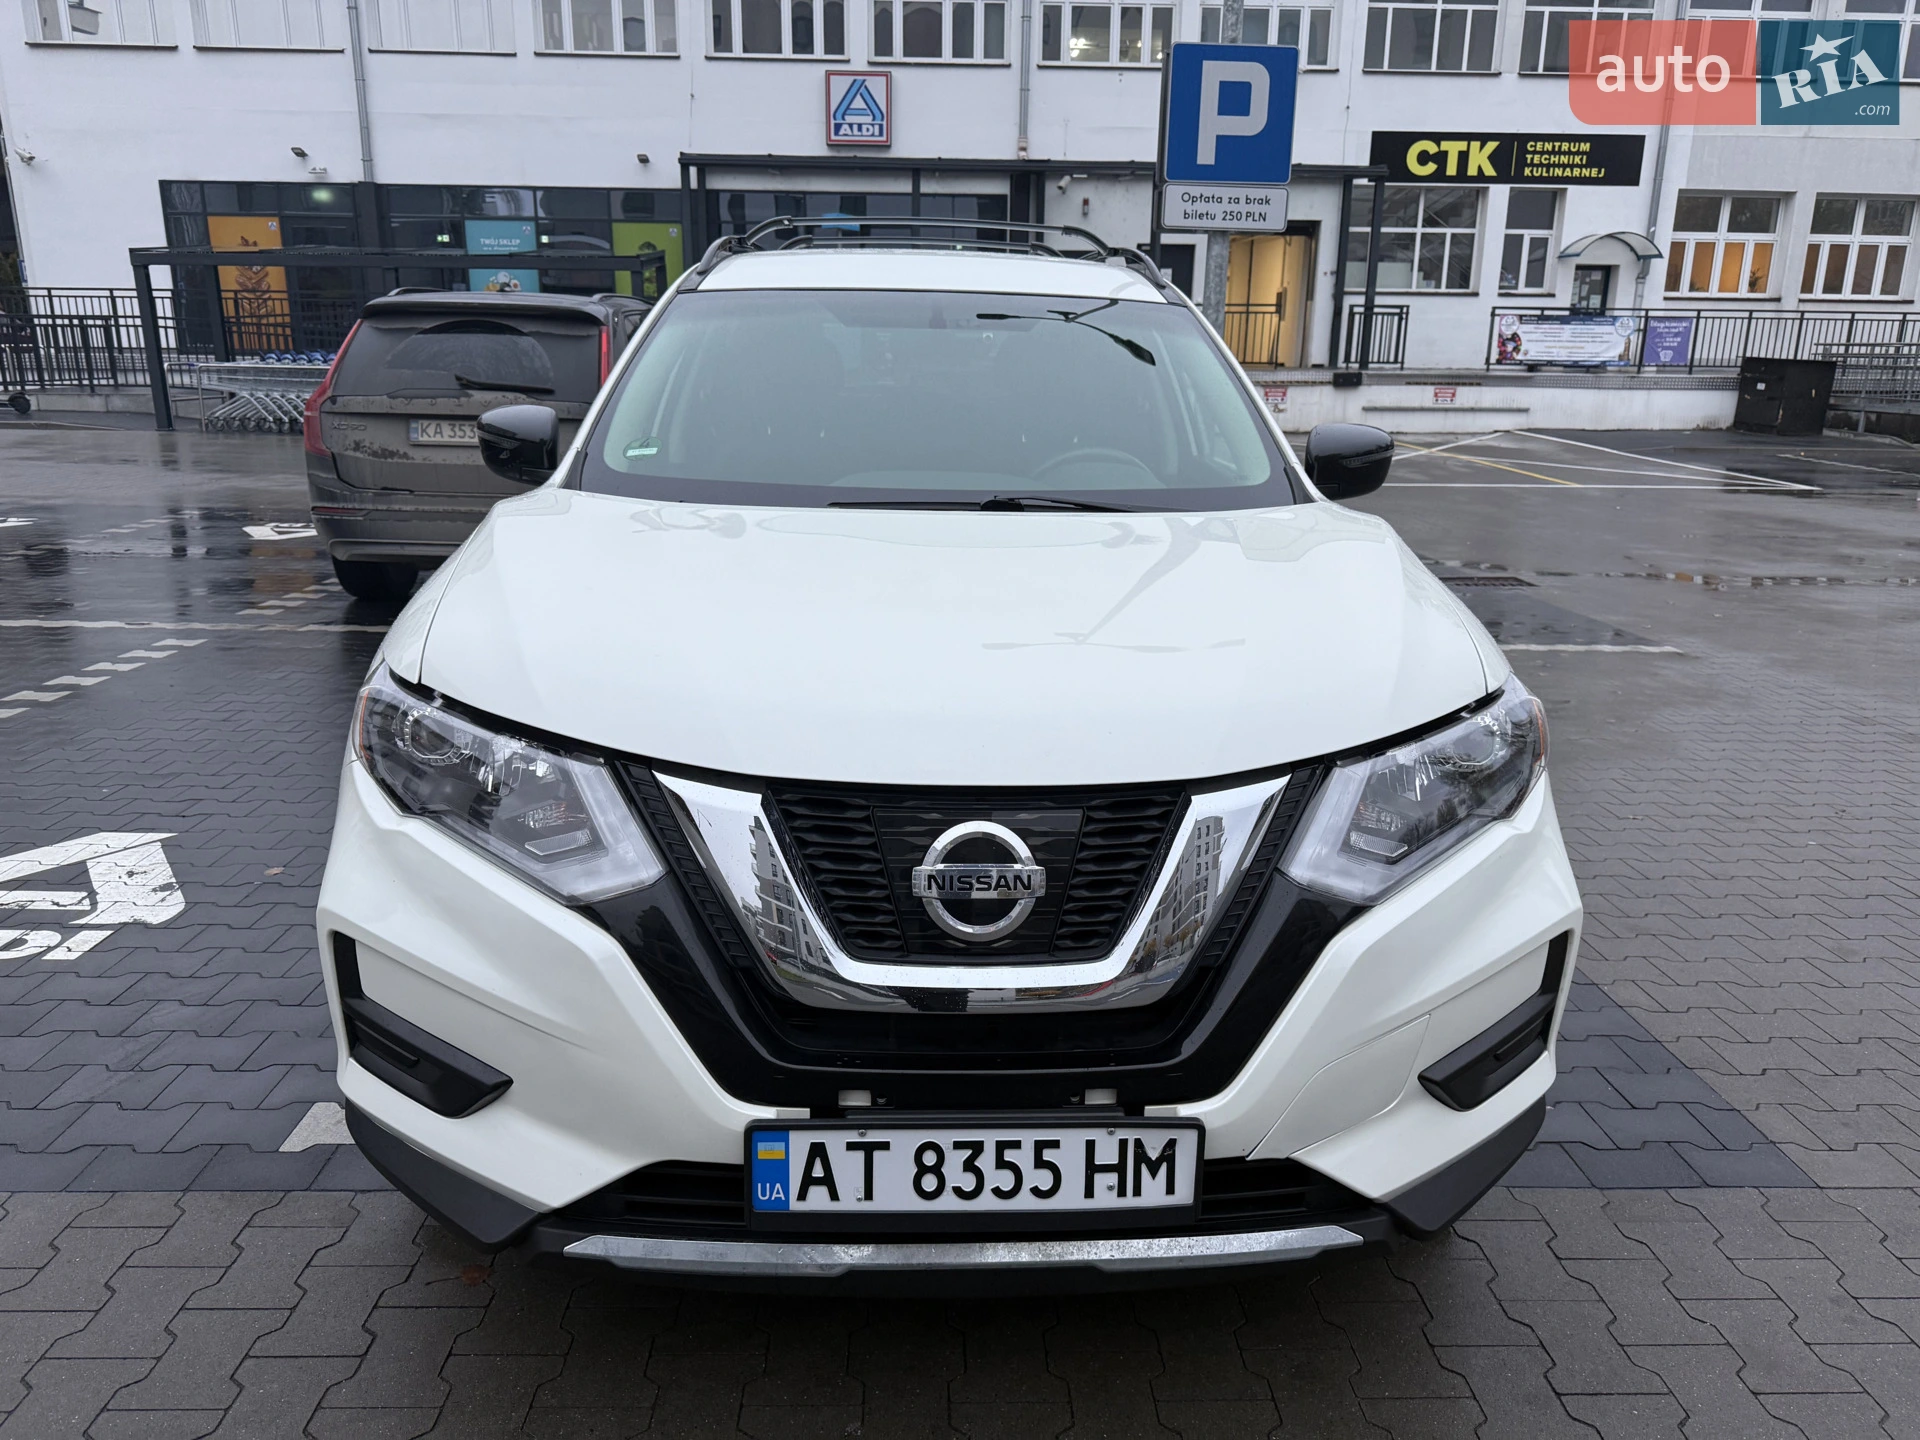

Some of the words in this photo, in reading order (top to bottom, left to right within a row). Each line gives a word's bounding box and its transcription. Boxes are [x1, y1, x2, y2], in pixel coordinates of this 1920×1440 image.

[1196, 60, 1271, 165] P
[838, 123, 880, 136] ALDI
[1526, 141, 1591, 152] CENTRUM
[1405, 139, 1500, 177] CTK
[1525, 154, 1587, 165] TECHNIKI
[1523, 167, 1605, 178] KULINARNEJ
[1181, 191, 1223, 206] Opłata
[1227, 196, 1240, 205] za
[1245, 194, 1271, 206] brak
[1183, 209, 1216, 221] biletu
[1221, 210, 1243, 222] 250
[1245, 212, 1267, 222] PLN
[420, 422, 444, 439] KA
[448, 422, 477, 440] 353
[926, 874, 1032, 892] NISSAN
[757, 1181, 786, 1201] UA
[796, 1140, 891, 1202] AT
[912, 1138, 1063, 1201] 8355
[1083, 1137, 1178, 1198] HM
